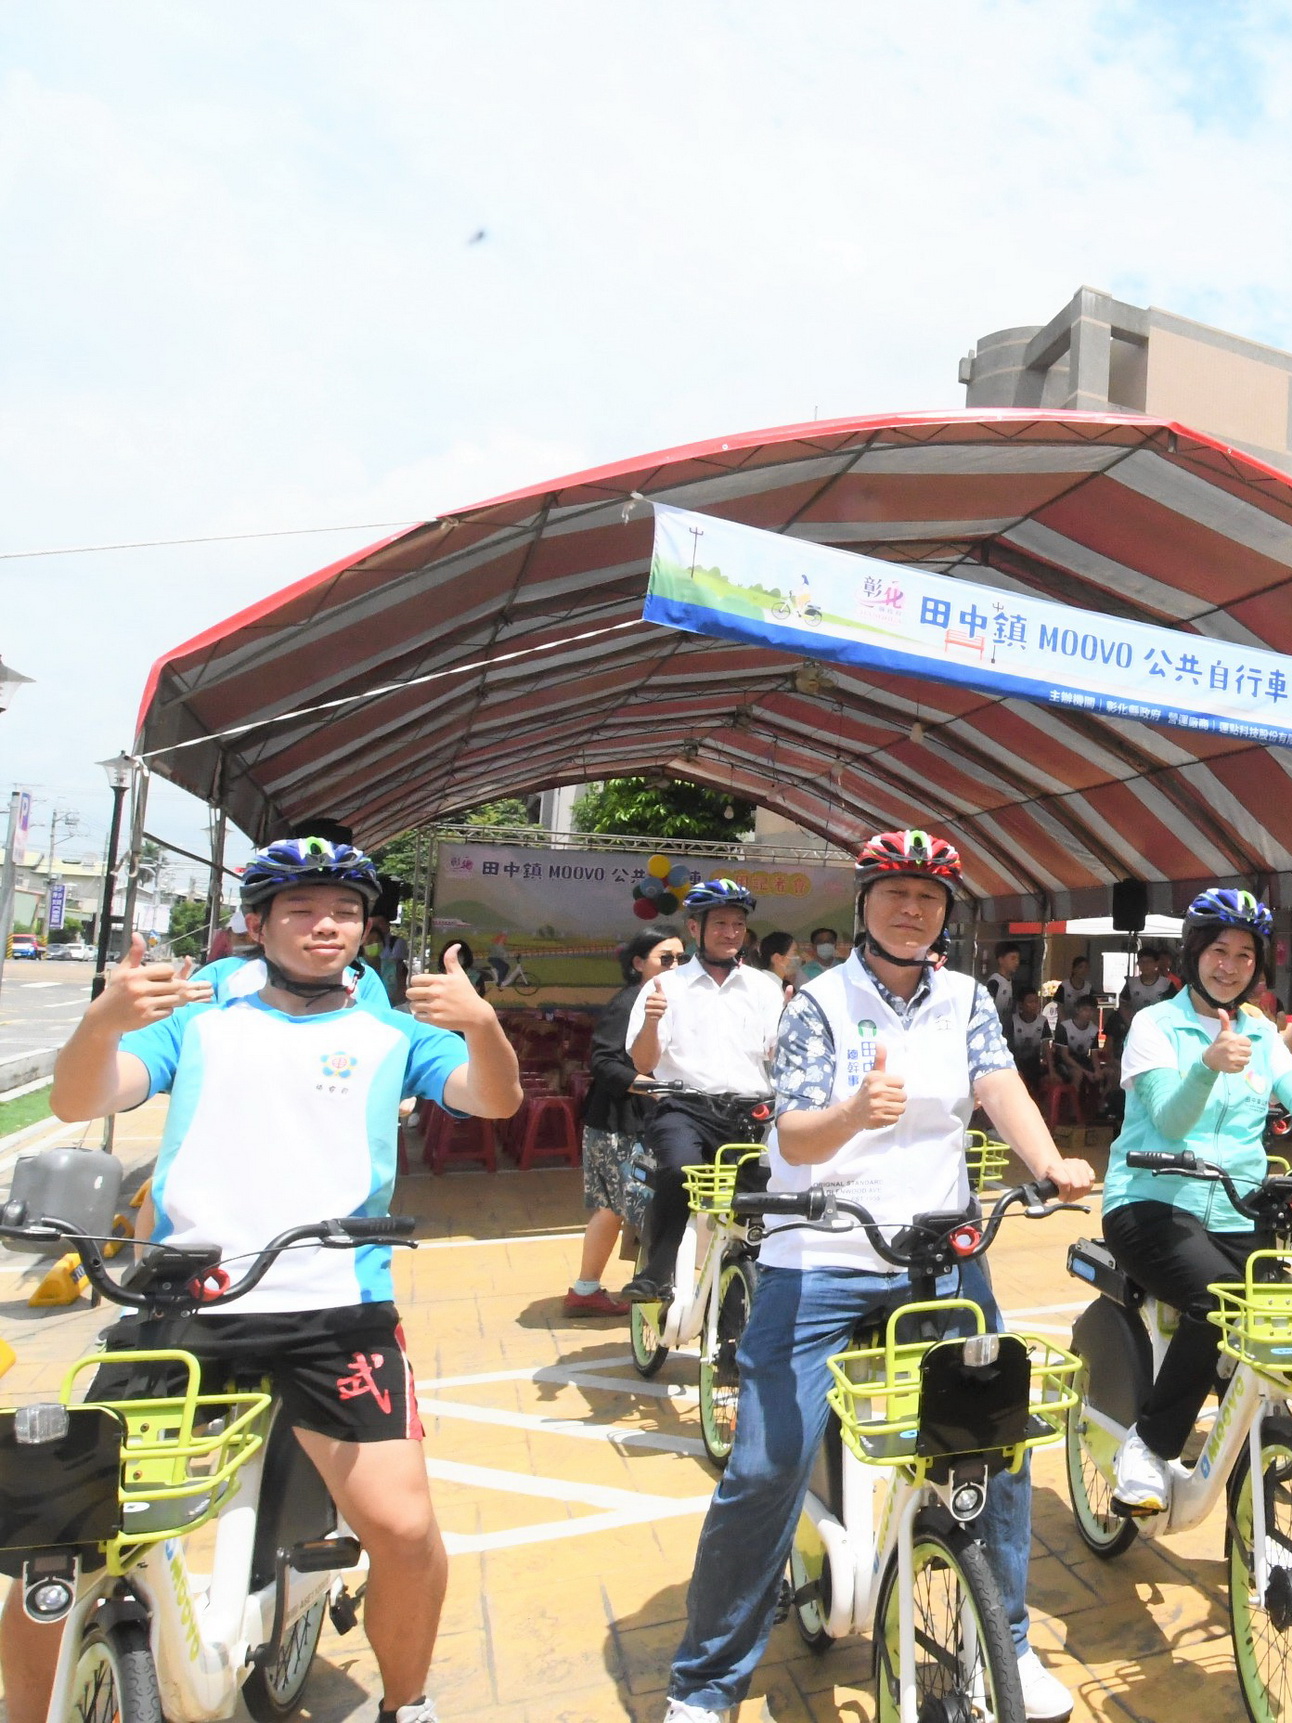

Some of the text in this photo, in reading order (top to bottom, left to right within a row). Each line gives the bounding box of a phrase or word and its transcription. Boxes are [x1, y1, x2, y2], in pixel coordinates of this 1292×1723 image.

[919, 595, 1028, 651] 田中鎮
[1038, 624, 1133, 669] MOOVO
[1143, 647, 1289, 703] 公共自行車
[482, 861, 543, 880] 田中鎮
[549, 865, 604, 881] MOOVO
[612, 868, 701, 885] 公共車
[1208, 1375, 1245, 1464] MOOVO
